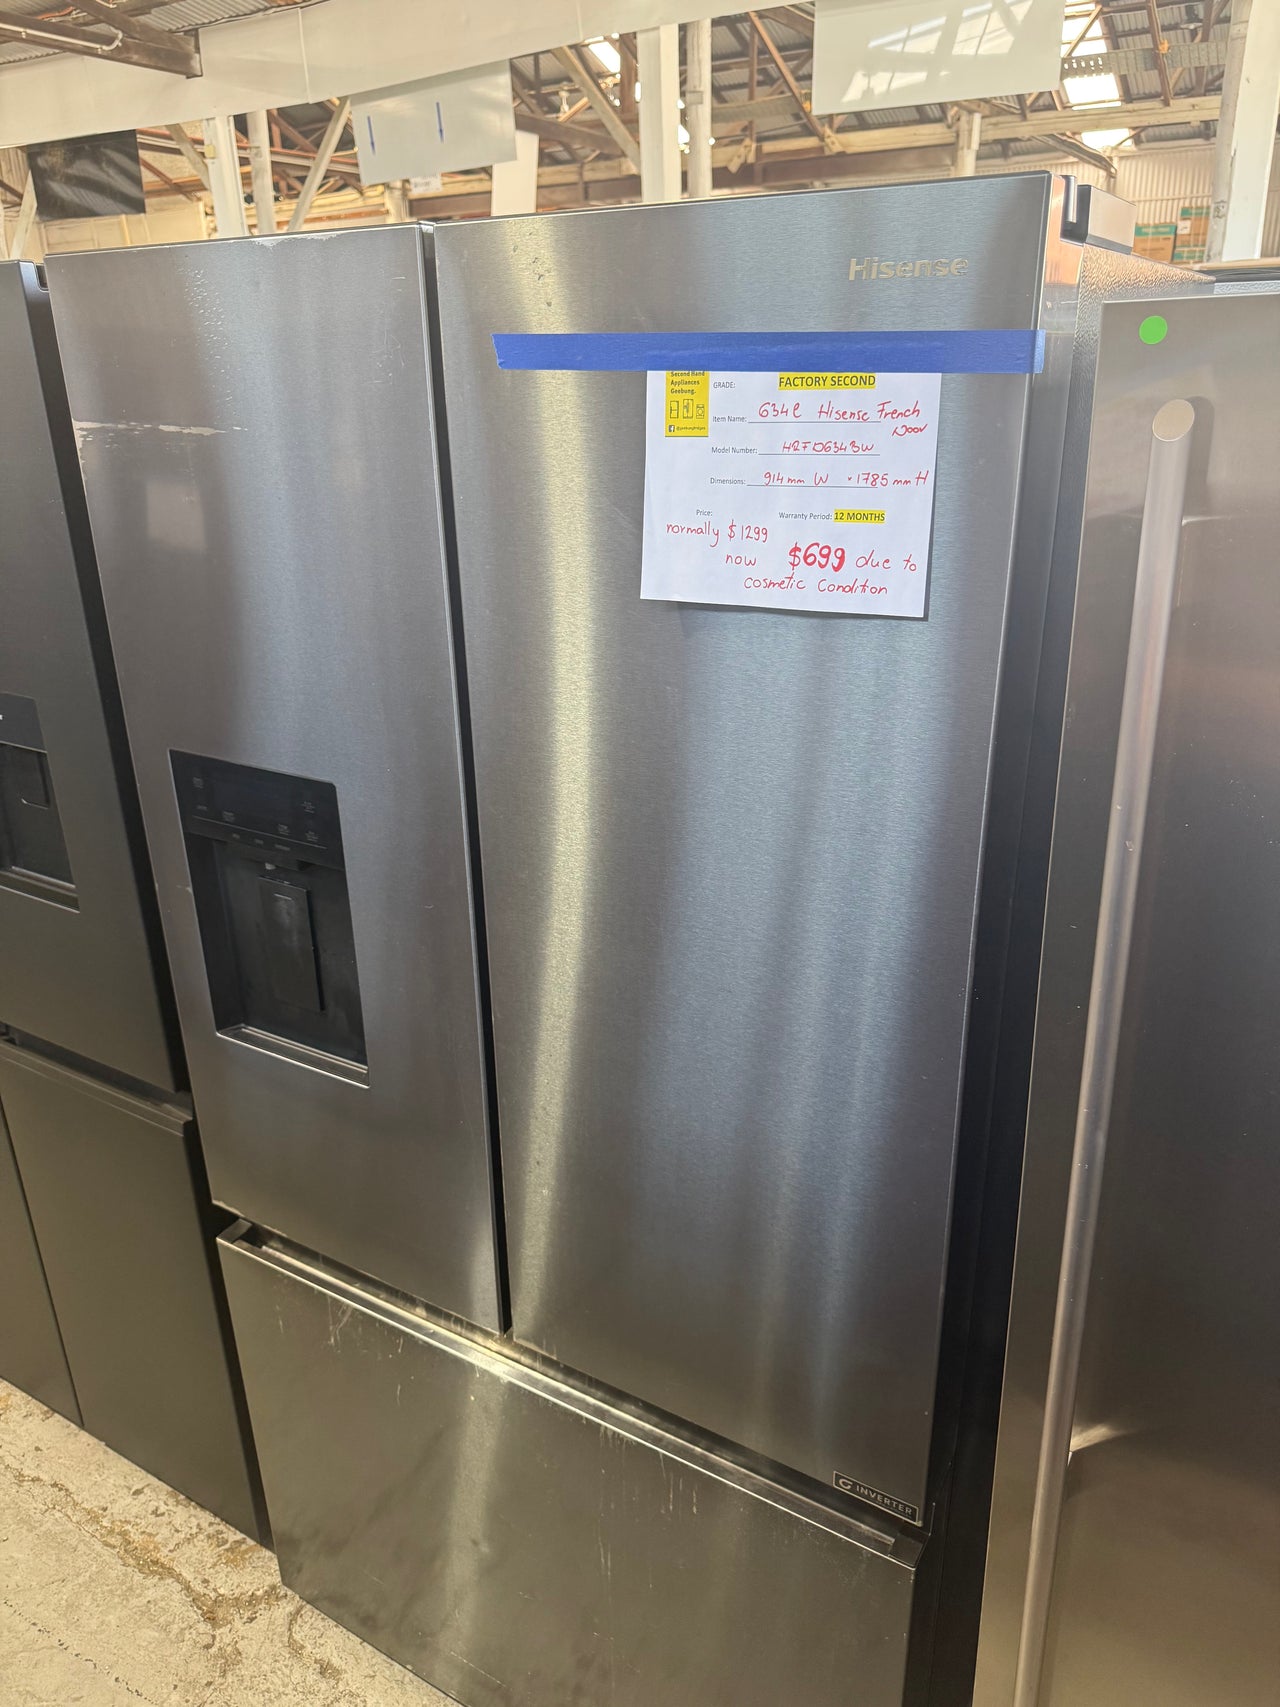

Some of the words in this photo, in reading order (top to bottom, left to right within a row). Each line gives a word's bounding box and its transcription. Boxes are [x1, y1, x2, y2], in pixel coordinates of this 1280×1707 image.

[848, 257, 969, 281] Hisense
[670, 379, 700, 387] Appliances
[713, 381, 736, 389] GRADE:
[779, 376, 828, 388] FACTORY
[830, 375, 876, 387] SECOND
[818, 400, 870, 422] Hisense
[877, 400, 920, 420] French
[710, 477, 746, 485] Dimensions:
[814, 472, 829, 486] W
[915, 470, 929, 486] H
[695, 509, 713, 517] Price:
[778, 512, 808, 520] Warranty
[834, 512, 845, 521] 12
[846, 513, 885, 522] MONTHS
[666, 520, 720, 548] normally
[725, 554, 757, 566] now
[788, 541, 846, 573] $699
[855, 549, 892, 570] due
[903, 553, 918, 572] to
[743, 571, 807, 591] cosmetic
[817, 577, 888, 595] Condition
[855, 1484, 913, 1516] INVERTER
